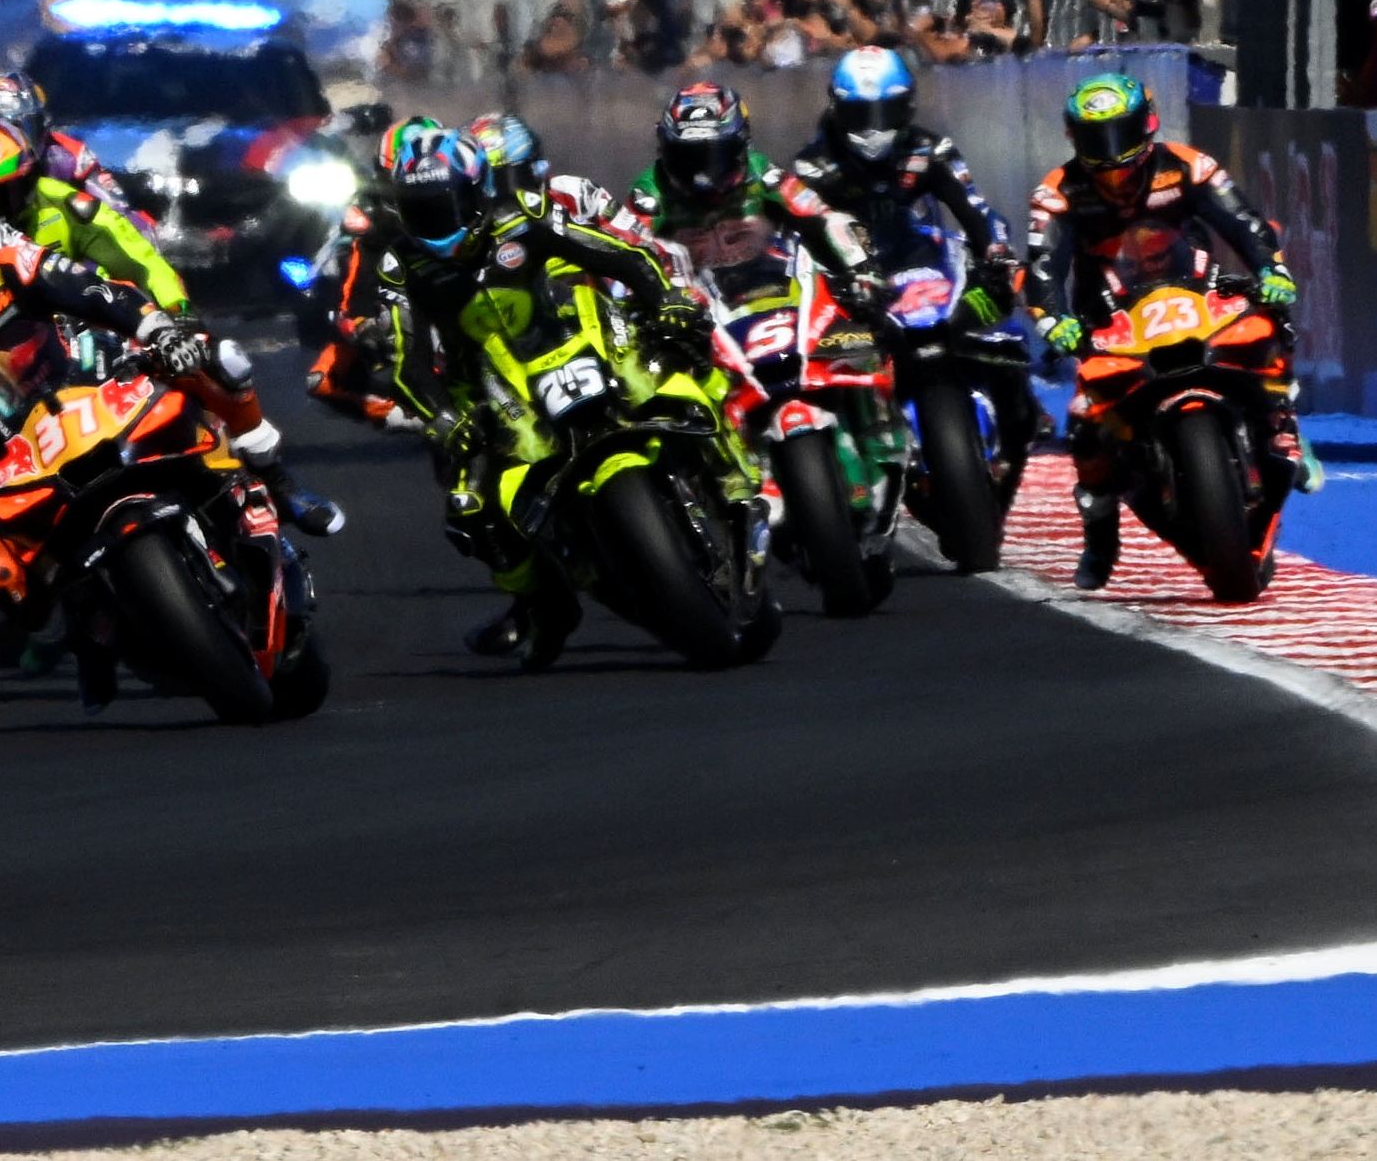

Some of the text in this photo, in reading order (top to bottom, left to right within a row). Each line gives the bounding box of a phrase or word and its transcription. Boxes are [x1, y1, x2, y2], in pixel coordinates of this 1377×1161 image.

[1141, 295, 1200, 340] 23
[537, 357, 606, 420] 25
[35, 392, 101, 465] 37
